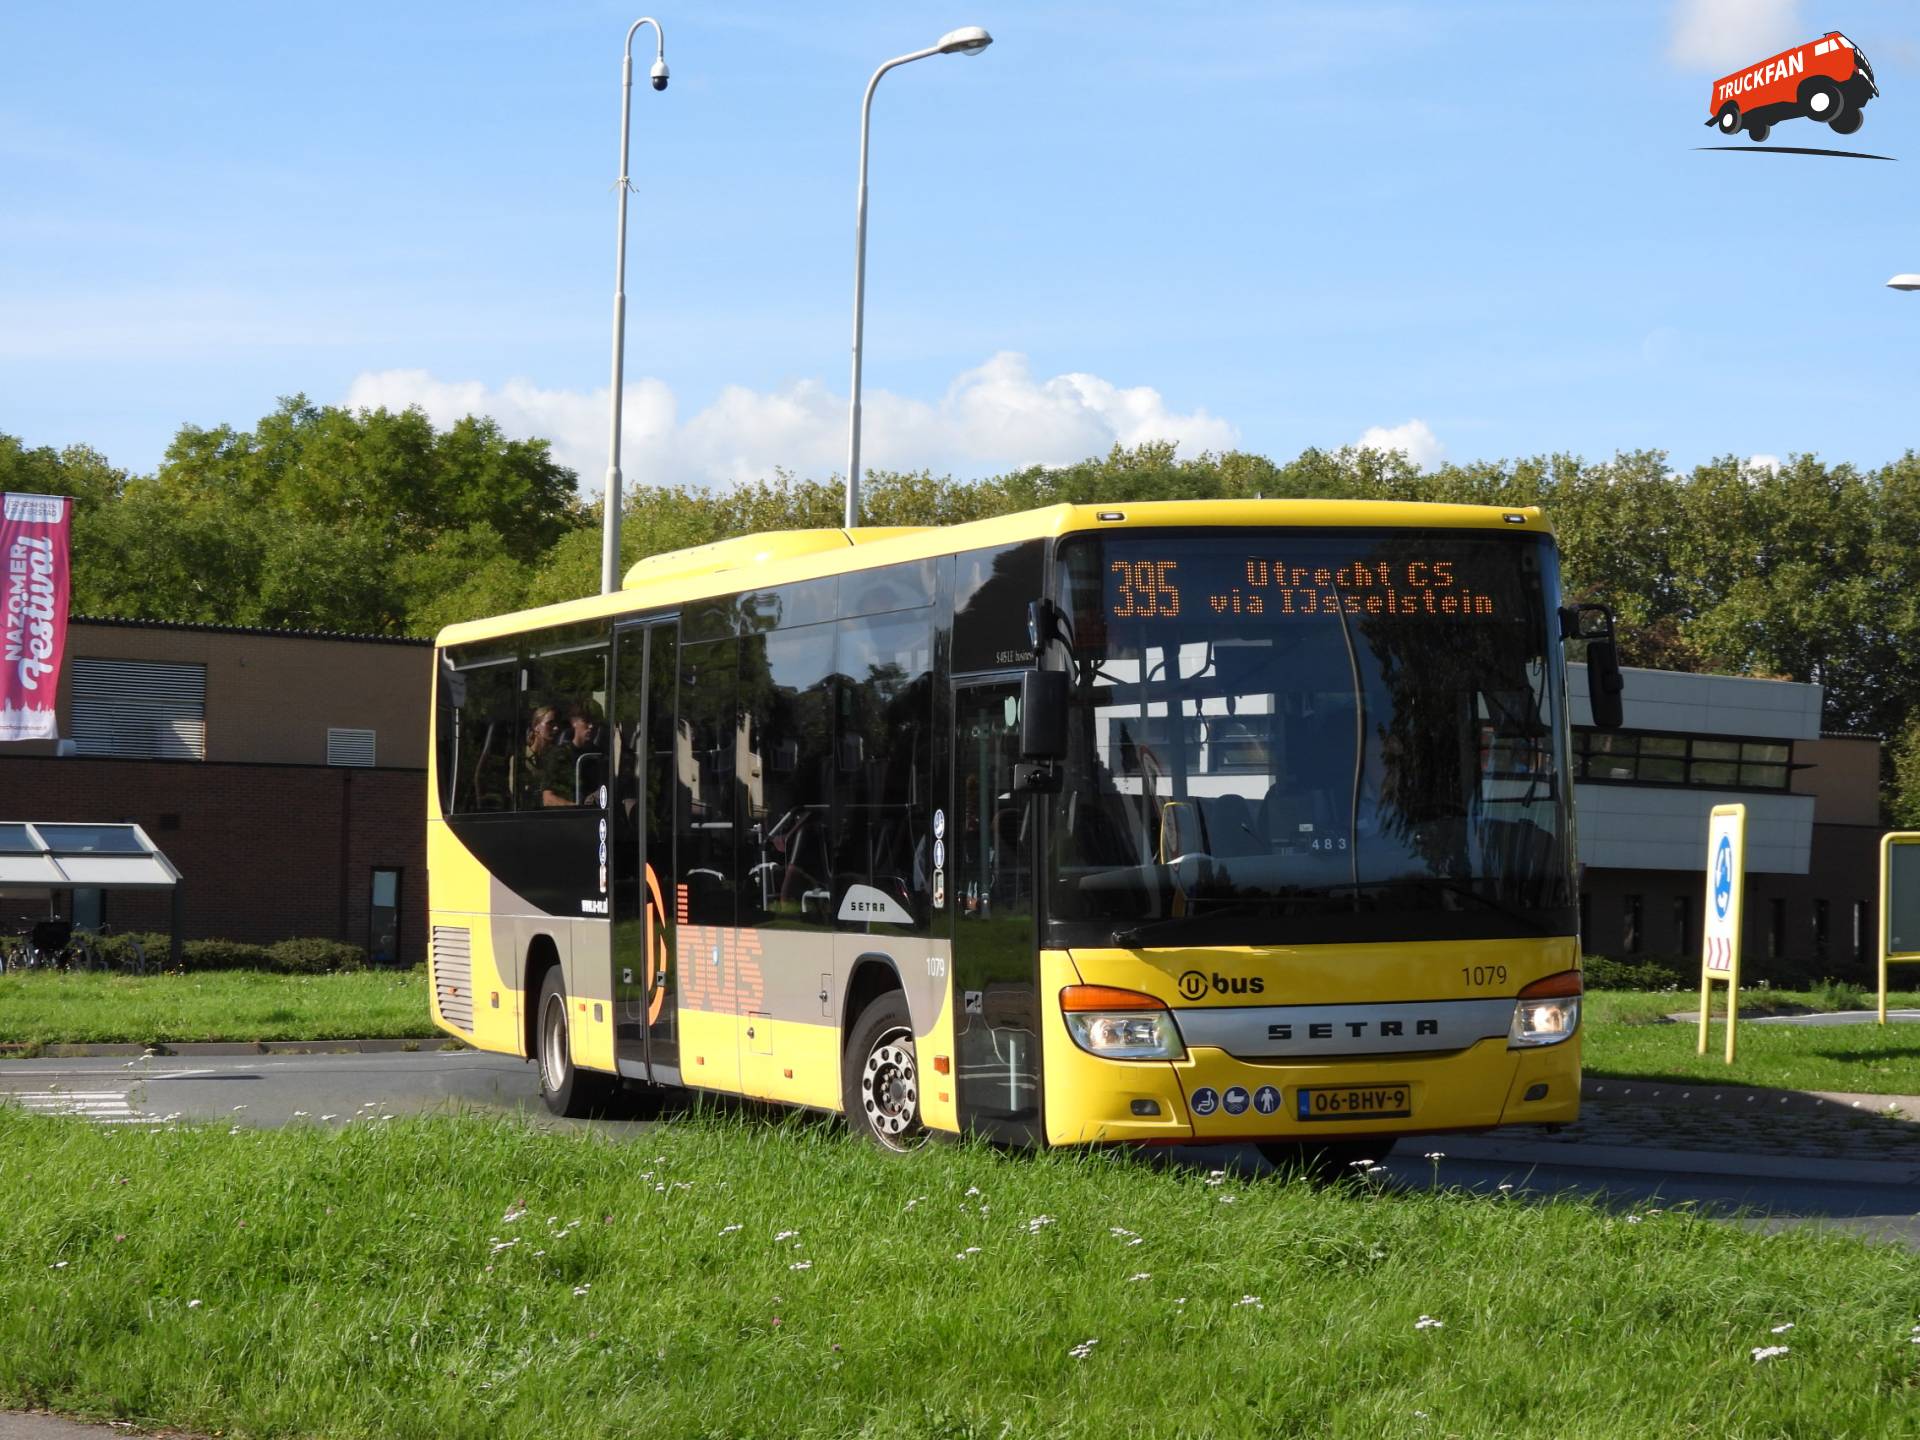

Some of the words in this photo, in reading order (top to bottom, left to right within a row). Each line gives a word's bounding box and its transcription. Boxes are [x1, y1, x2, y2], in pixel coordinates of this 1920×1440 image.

[1247, 561, 1390, 586] Utrecht
[1408, 562, 1453, 586] CS
[1112, 561, 1179, 616] 395
[5, 544, 27, 661] NAZOMER
[1210, 589, 1263, 613] via
[1280, 589, 1493, 614] IJsselstein
[18, 536, 54, 690] Festival
[851, 902, 885, 913] SETRA
[926, 957, 945, 977] 1079
[1462, 966, 1507, 986] 1079
[1212, 972, 1265, 994] bus
[1268, 1019, 1439, 1040] SETRA
[1315, 1091, 1405, 1112] 06-BHV-9
